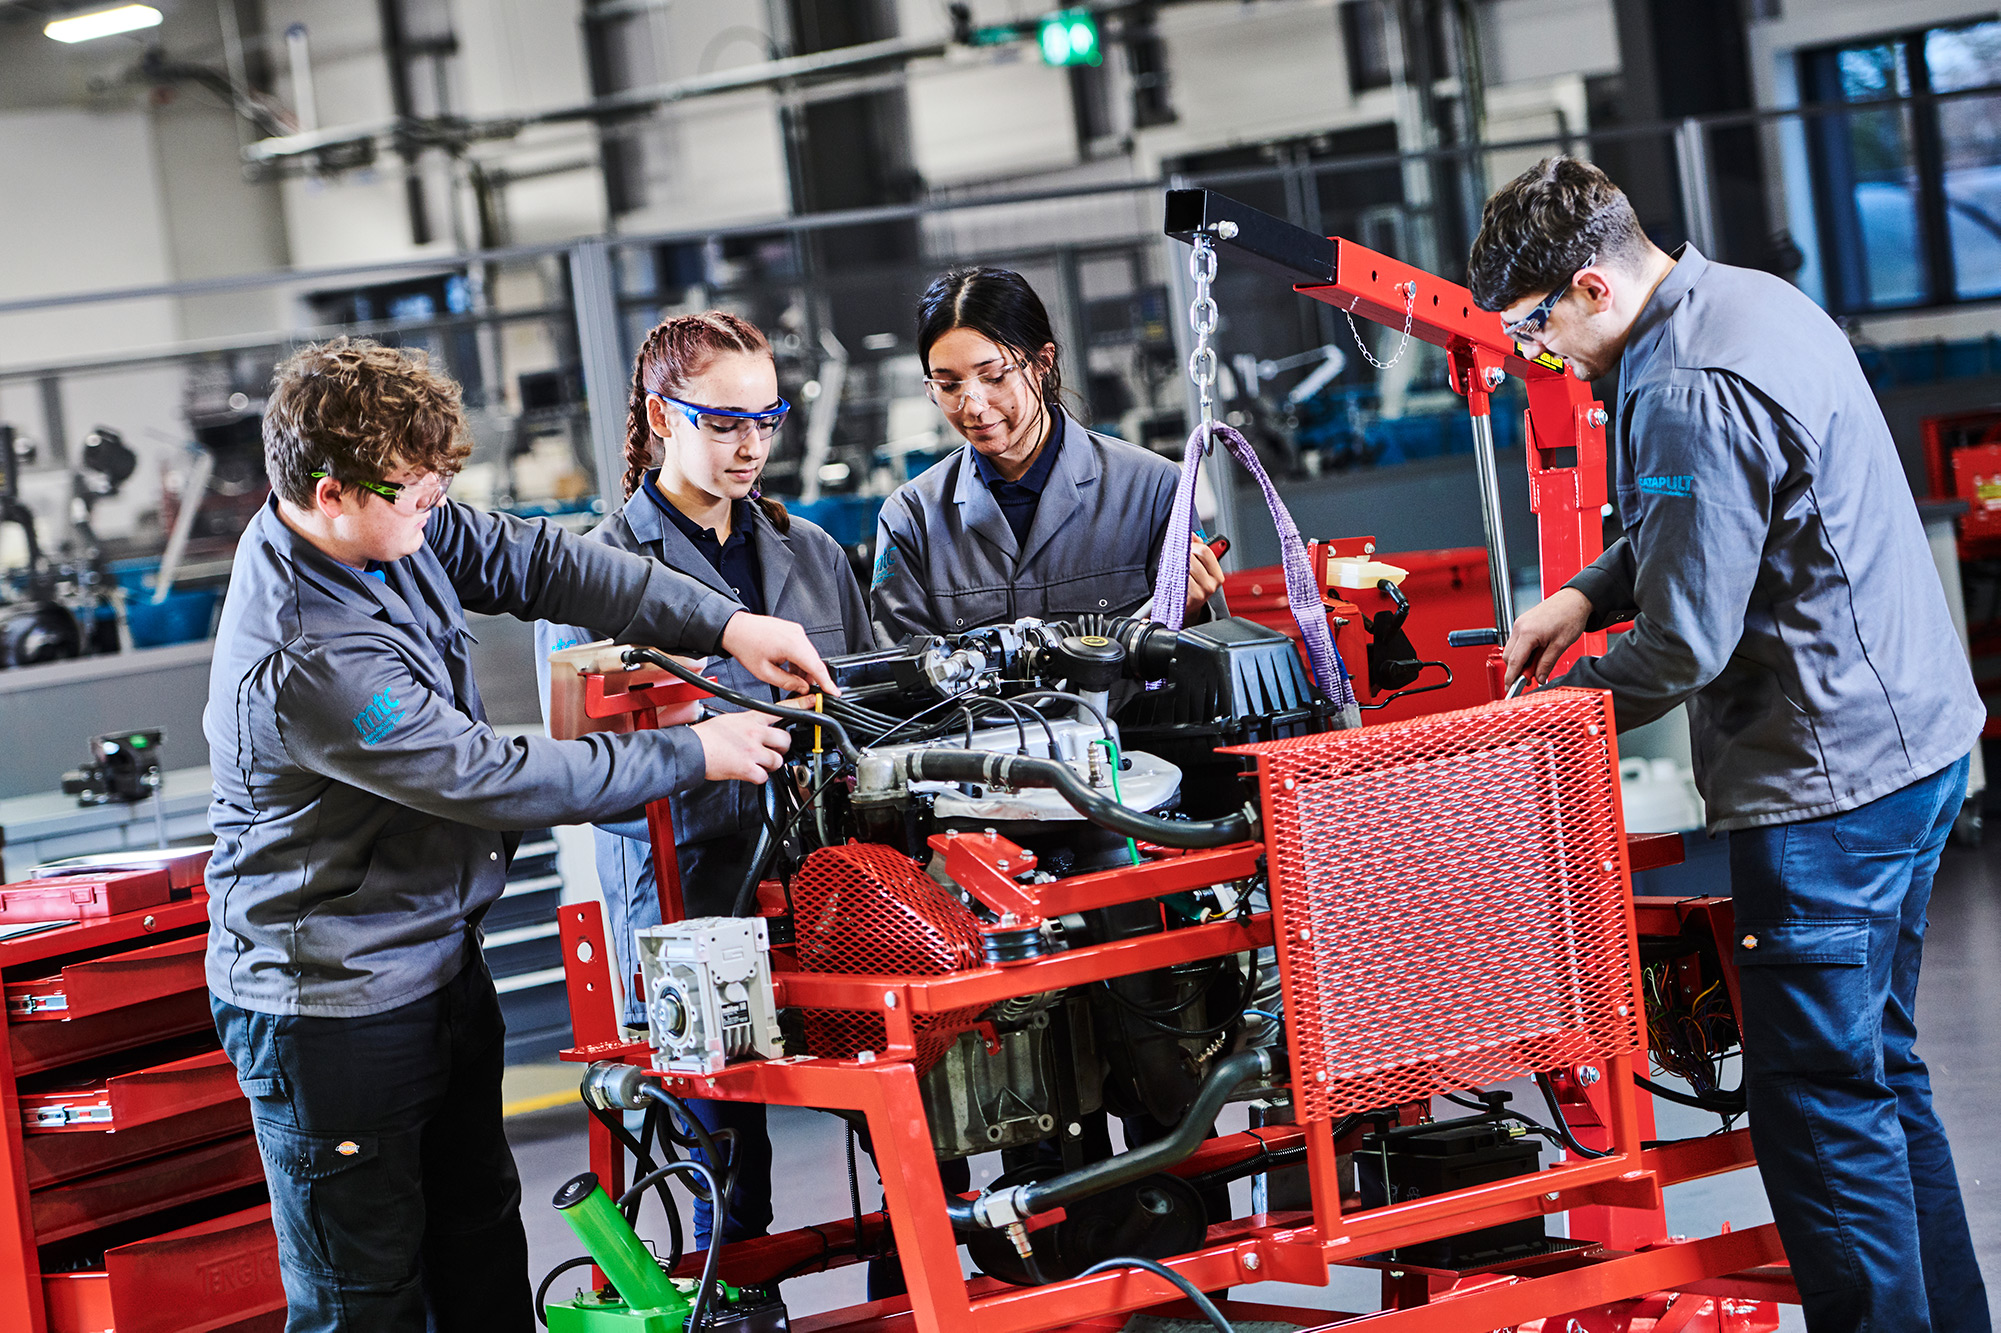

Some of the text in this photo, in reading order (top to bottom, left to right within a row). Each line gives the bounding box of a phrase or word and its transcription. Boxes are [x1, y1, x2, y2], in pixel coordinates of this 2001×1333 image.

[1638, 475, 1694, 491] CATAPULT
[352, 686, 400, 735] mtc
[195, 1245, 279, 1299] TENGTO
